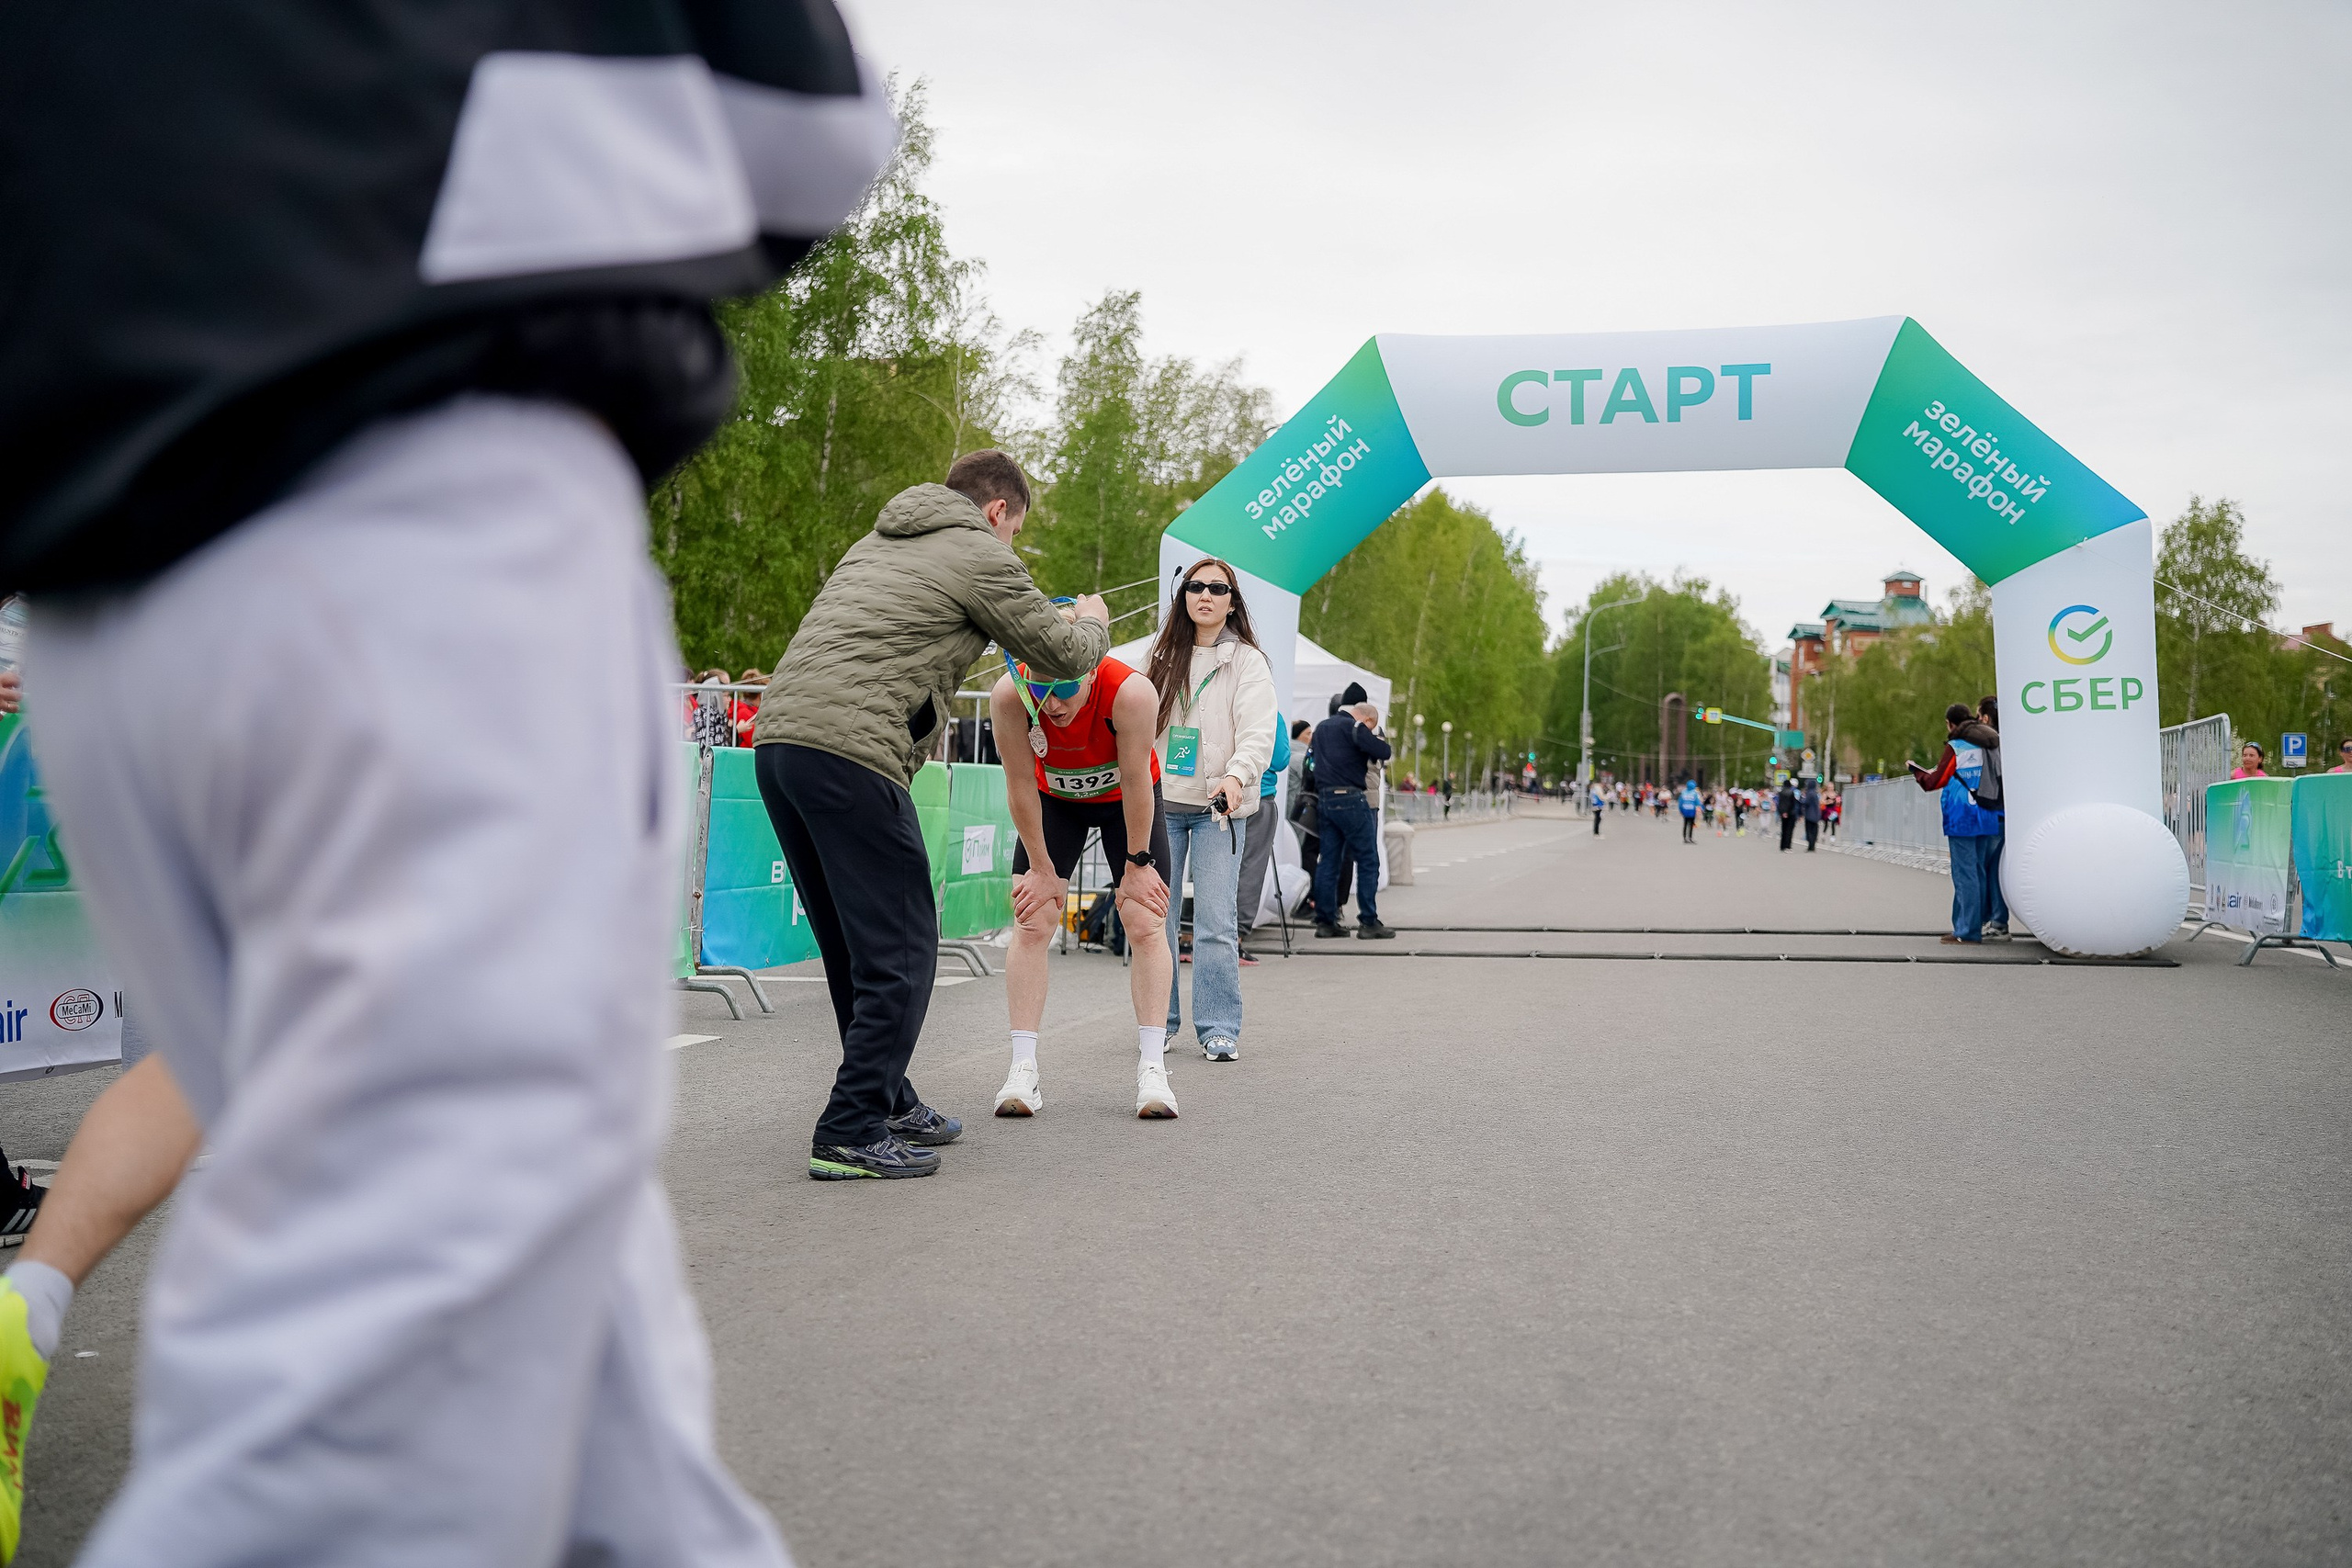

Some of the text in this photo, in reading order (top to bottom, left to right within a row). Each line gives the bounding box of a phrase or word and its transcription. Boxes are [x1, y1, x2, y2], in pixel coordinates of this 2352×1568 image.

[1497, 363, 1771, 427] СТАРТ
[1245, 413, 1352, 521] зелёный
[1902, 420, 2026, 525] марафон
[1924, 400, 2052, 504] зелёный
[1261, 436, 1371, 540] марафон
[2021, 677, 2143, 714] СБЕР
[2290, 737, 2302, 755] P
[1055, 772, 1115, 790] 1392
[0, 999, 28, 1043] ir
[62, 1002, 92, 1017] MeCaMi
